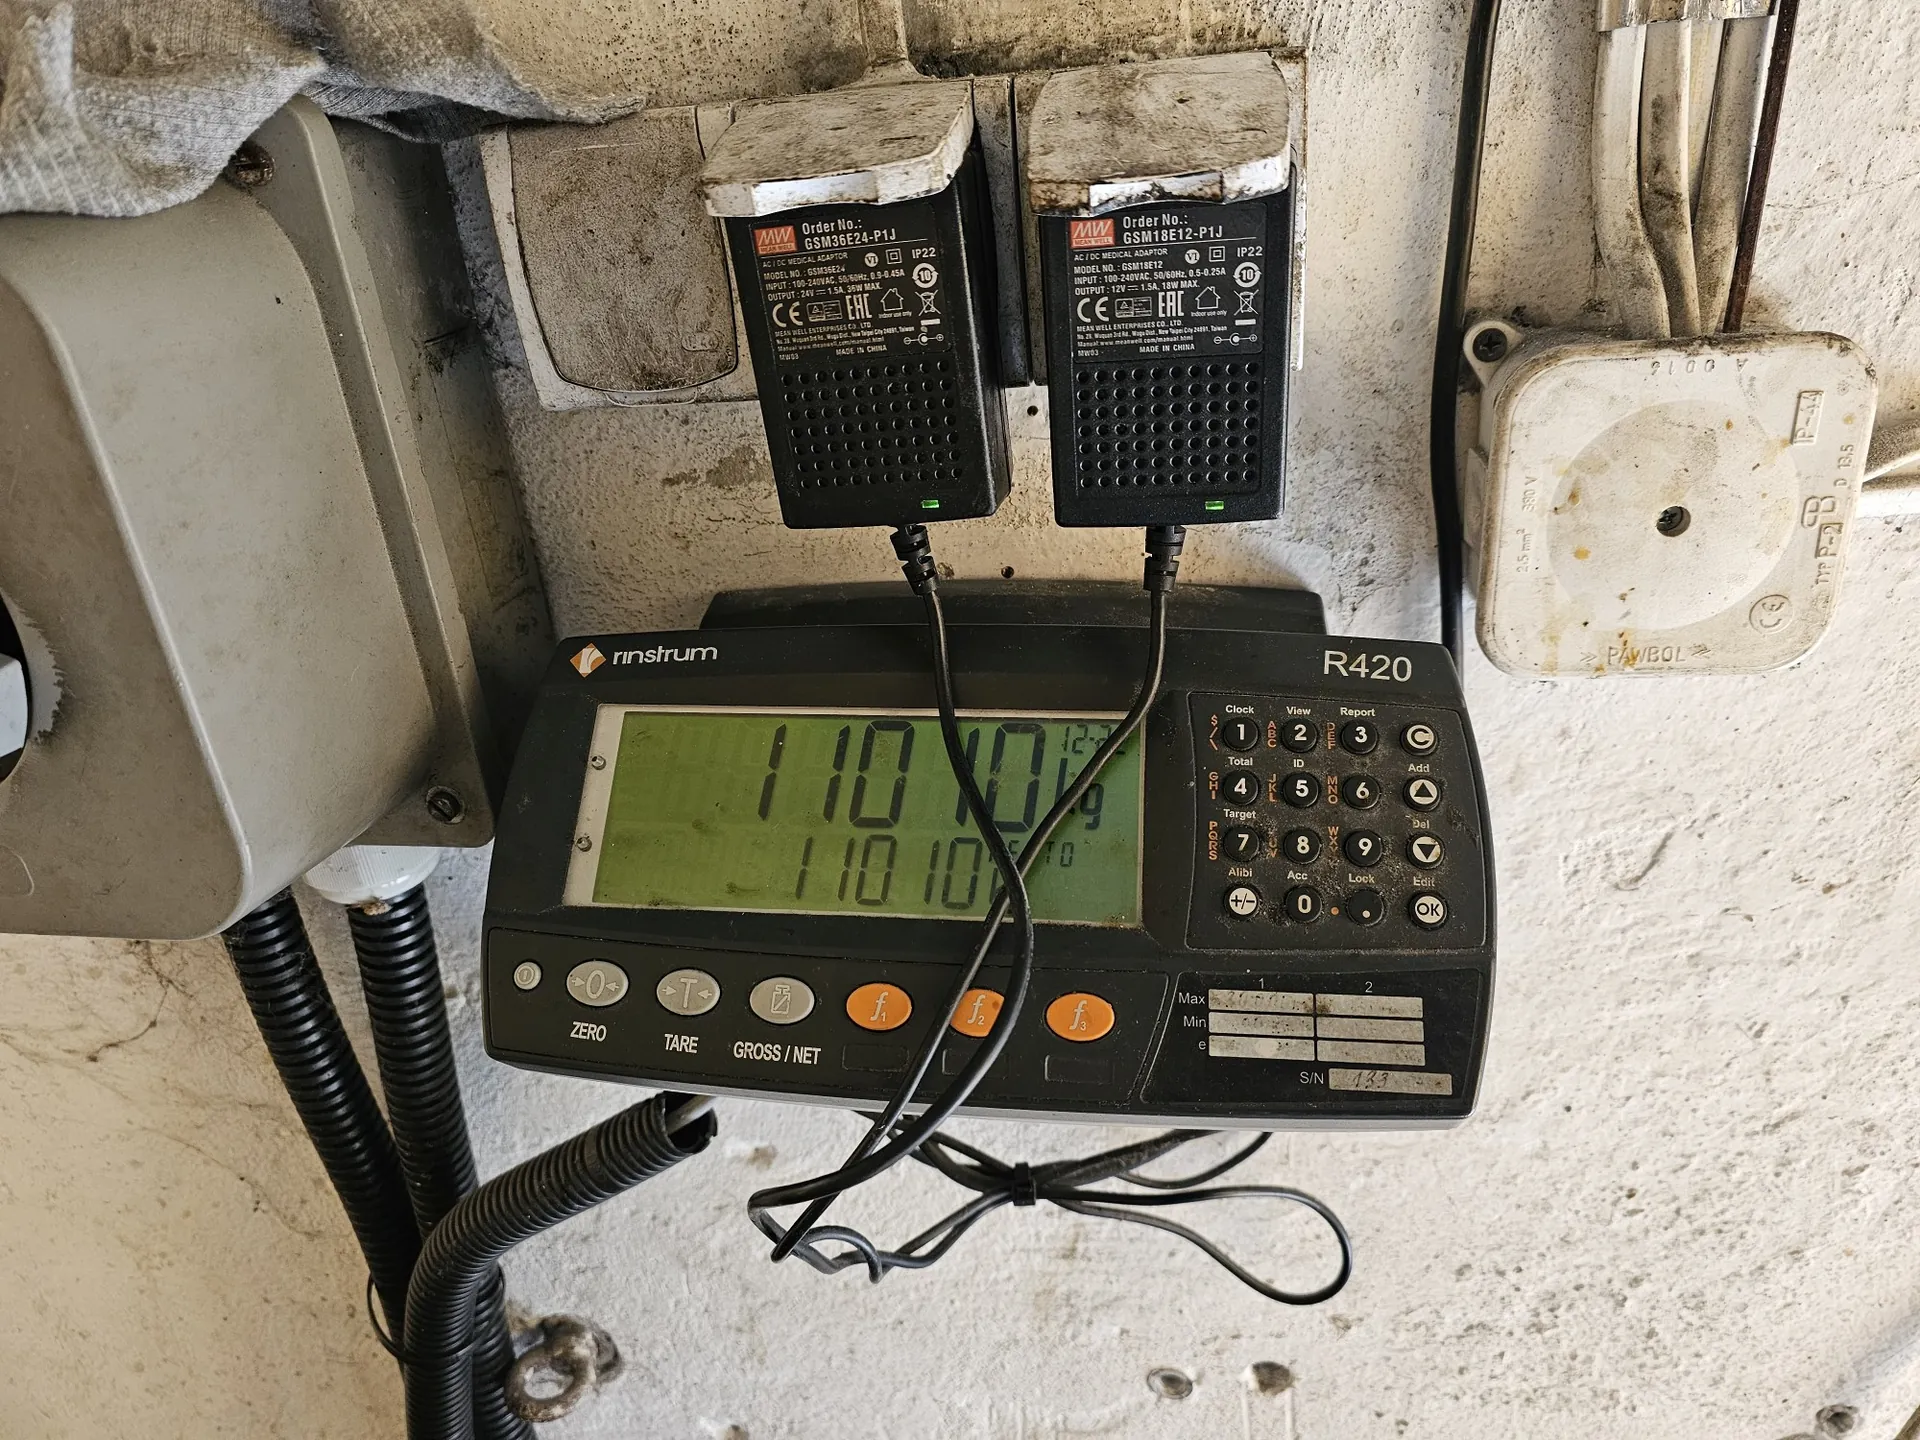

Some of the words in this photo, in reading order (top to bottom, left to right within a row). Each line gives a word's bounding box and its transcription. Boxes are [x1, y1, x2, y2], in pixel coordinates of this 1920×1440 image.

[801, 221, 836, 235] Order
[1122, 215, 1159, 229] Order
[804, 227, 897, 250] GSM36E24-P1J
[1123, 225, 1223, 245] GSM18E12-P1J
[787, 255, 816, 265] MEDICAL
[817, 251, 849, 261] ADAPTOR
[911, 246, 937, 259] IP22
[1101, 250, 1133, 260] MEDICAL
[1134, 248, 1168, 257] ADAPTOR
[1236, 245, 1263, 258] IP22
[1073, 265, 1101, 275] MODEL
[1121, 259, 1163, 271] GSM18E12
[763, 270, 789, 281] MODEL
[1074, 275, 1098, 285] INPUT
[1188, 266, 1227, 278] 0.5-0.25A
[765, 280, 787, 292] INPUT
[1074, 285, 1105, 296] OUTPUT
[1111, 284, 1126, 294] 12V
[1161, 281, 1179, 290] 18W
[767, 291, 796, 302] OUTPUT
[800, 289, 815, 298] 24V
[772, 301, 804, 328] CE
[1076, 295, 1110, 323] CE
[1113, 321, 1156, 330] ENTERPRISES
[835, 347, 856, 356] MADE
[866, 344, 888, 353] CHINA
[1139, 345, 1160, 353] MADE
[1173, 343, 1195, 352] CHINA
[612, 645, 718, 665] rinstrum
[1607, 645, 1686, 666] PAWBOL
[1323, 650, 1412, 682] R420
[1225, 704, 1255, 714] Clock
[1286, 705, 1312, 715] View
[1340, 706, 1376, 718] Report
[1236, 723, 1245, 741] 1
[1294, 724, 1307, 741] 2
[1354, 726, 1368, 743] 3
[1228, 756, 1254, 766] Total
[1293, 758, 1305, 768] ID
[1407, 763, 1430, 773] Add
[1234, 777, 1248, 795] 4
[1295, 779, 1309, 798] 5
[1356, 781, 1370, 800] 6
[1223, 808, 1257, 821] Target
[1412, 818, 1430, 829] Del
[1237, 833, 1250, 851] 7
[1296, 835, 1310, 855] 8
[1358, 837, 1373, 856] 9
[1228, 867, 1253, 878] Alibi
[1287, 870, 1309, 880] Acc
[1348, 873, 1376, 884] Lock
[1413, 876, 1436, 887] Edit
[1297, 894, 1312, 914] 0
[1416, 902, 1441, 917] OK
[1258, 977, 1265, 990] 1
[1364, 981, 1373, 993] 2
[1178, 991, 1206, 1005] Max
[1183, 1015, 1207, 1028] Min
[569, 1020, 608, 1042] ZERO
[664, 1033, 700, 1054] TARE
[1198, 1040, 1207, 1050] e
[733, 1040, 782, 1063] GROSS
[793, 1046, 823, 1066] NET
[1299, 1071, 1325, 1085] S/N
